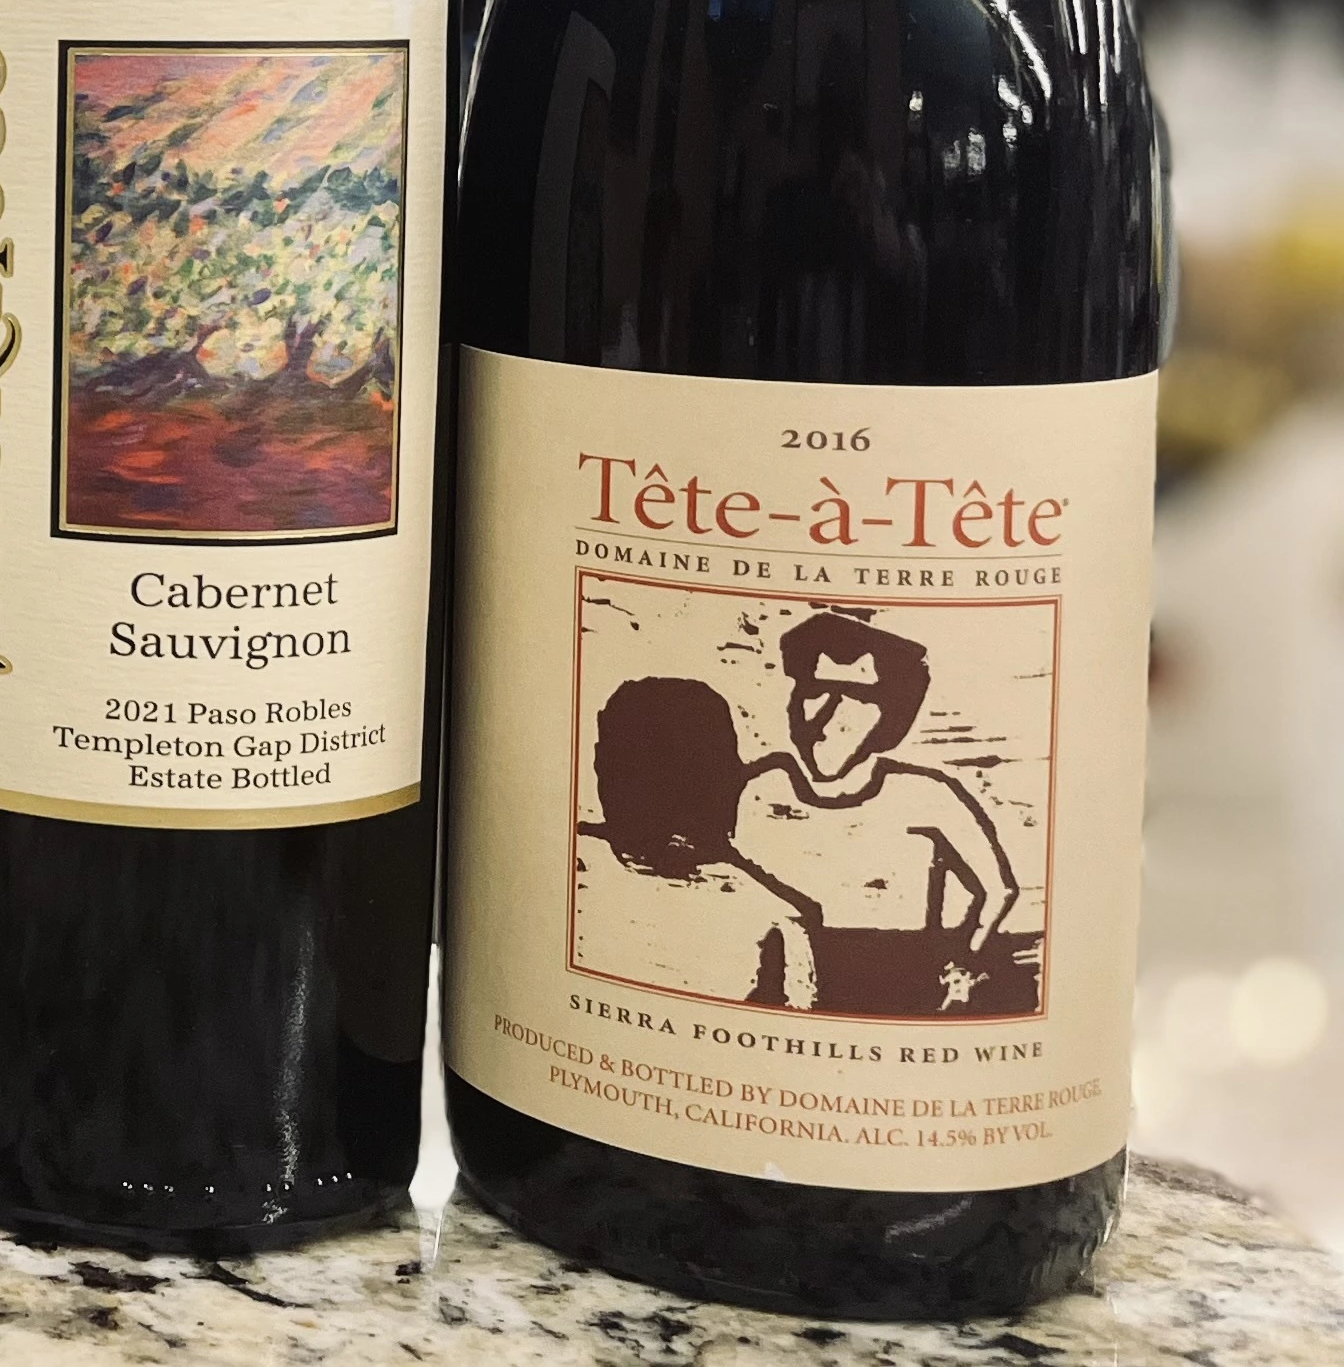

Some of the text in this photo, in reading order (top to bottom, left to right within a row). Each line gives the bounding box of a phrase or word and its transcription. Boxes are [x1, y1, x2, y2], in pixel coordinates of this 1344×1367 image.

[781, 427, 871, 452] 2016
[578, 451, 1063, 548] Tête-à-Tête
[575, 539, 1062, 587] DOMAINE DE LA TERRE ROUGE
[131, 572, 339, 609] Cabernet
[109, 621, 352, 670] Sauvignon
[105, 698, 352, 725] 2021 Paso Robles
[52, 723, 387, 762] Templeton Gap District
[128, 762, 332, 789] Estate Bottled
[569, 994, 1044, 1064] SIERRA FOOTHILLS RED WINE
[494, 1014, 1103, 1118] PRODUCED & BOTTLED BY DOMAINE DE LA TERRE ROUGE
[549, 1065, 679, 1120] PLYMOUTH,
[685, 1103, 849, 1145] CALIFORNIA.
[856, 1127, 909, 1147] ALC.
[916, 1128, 977, 1148] 14.5%
[983, 1124, 1009, 1146] BY
